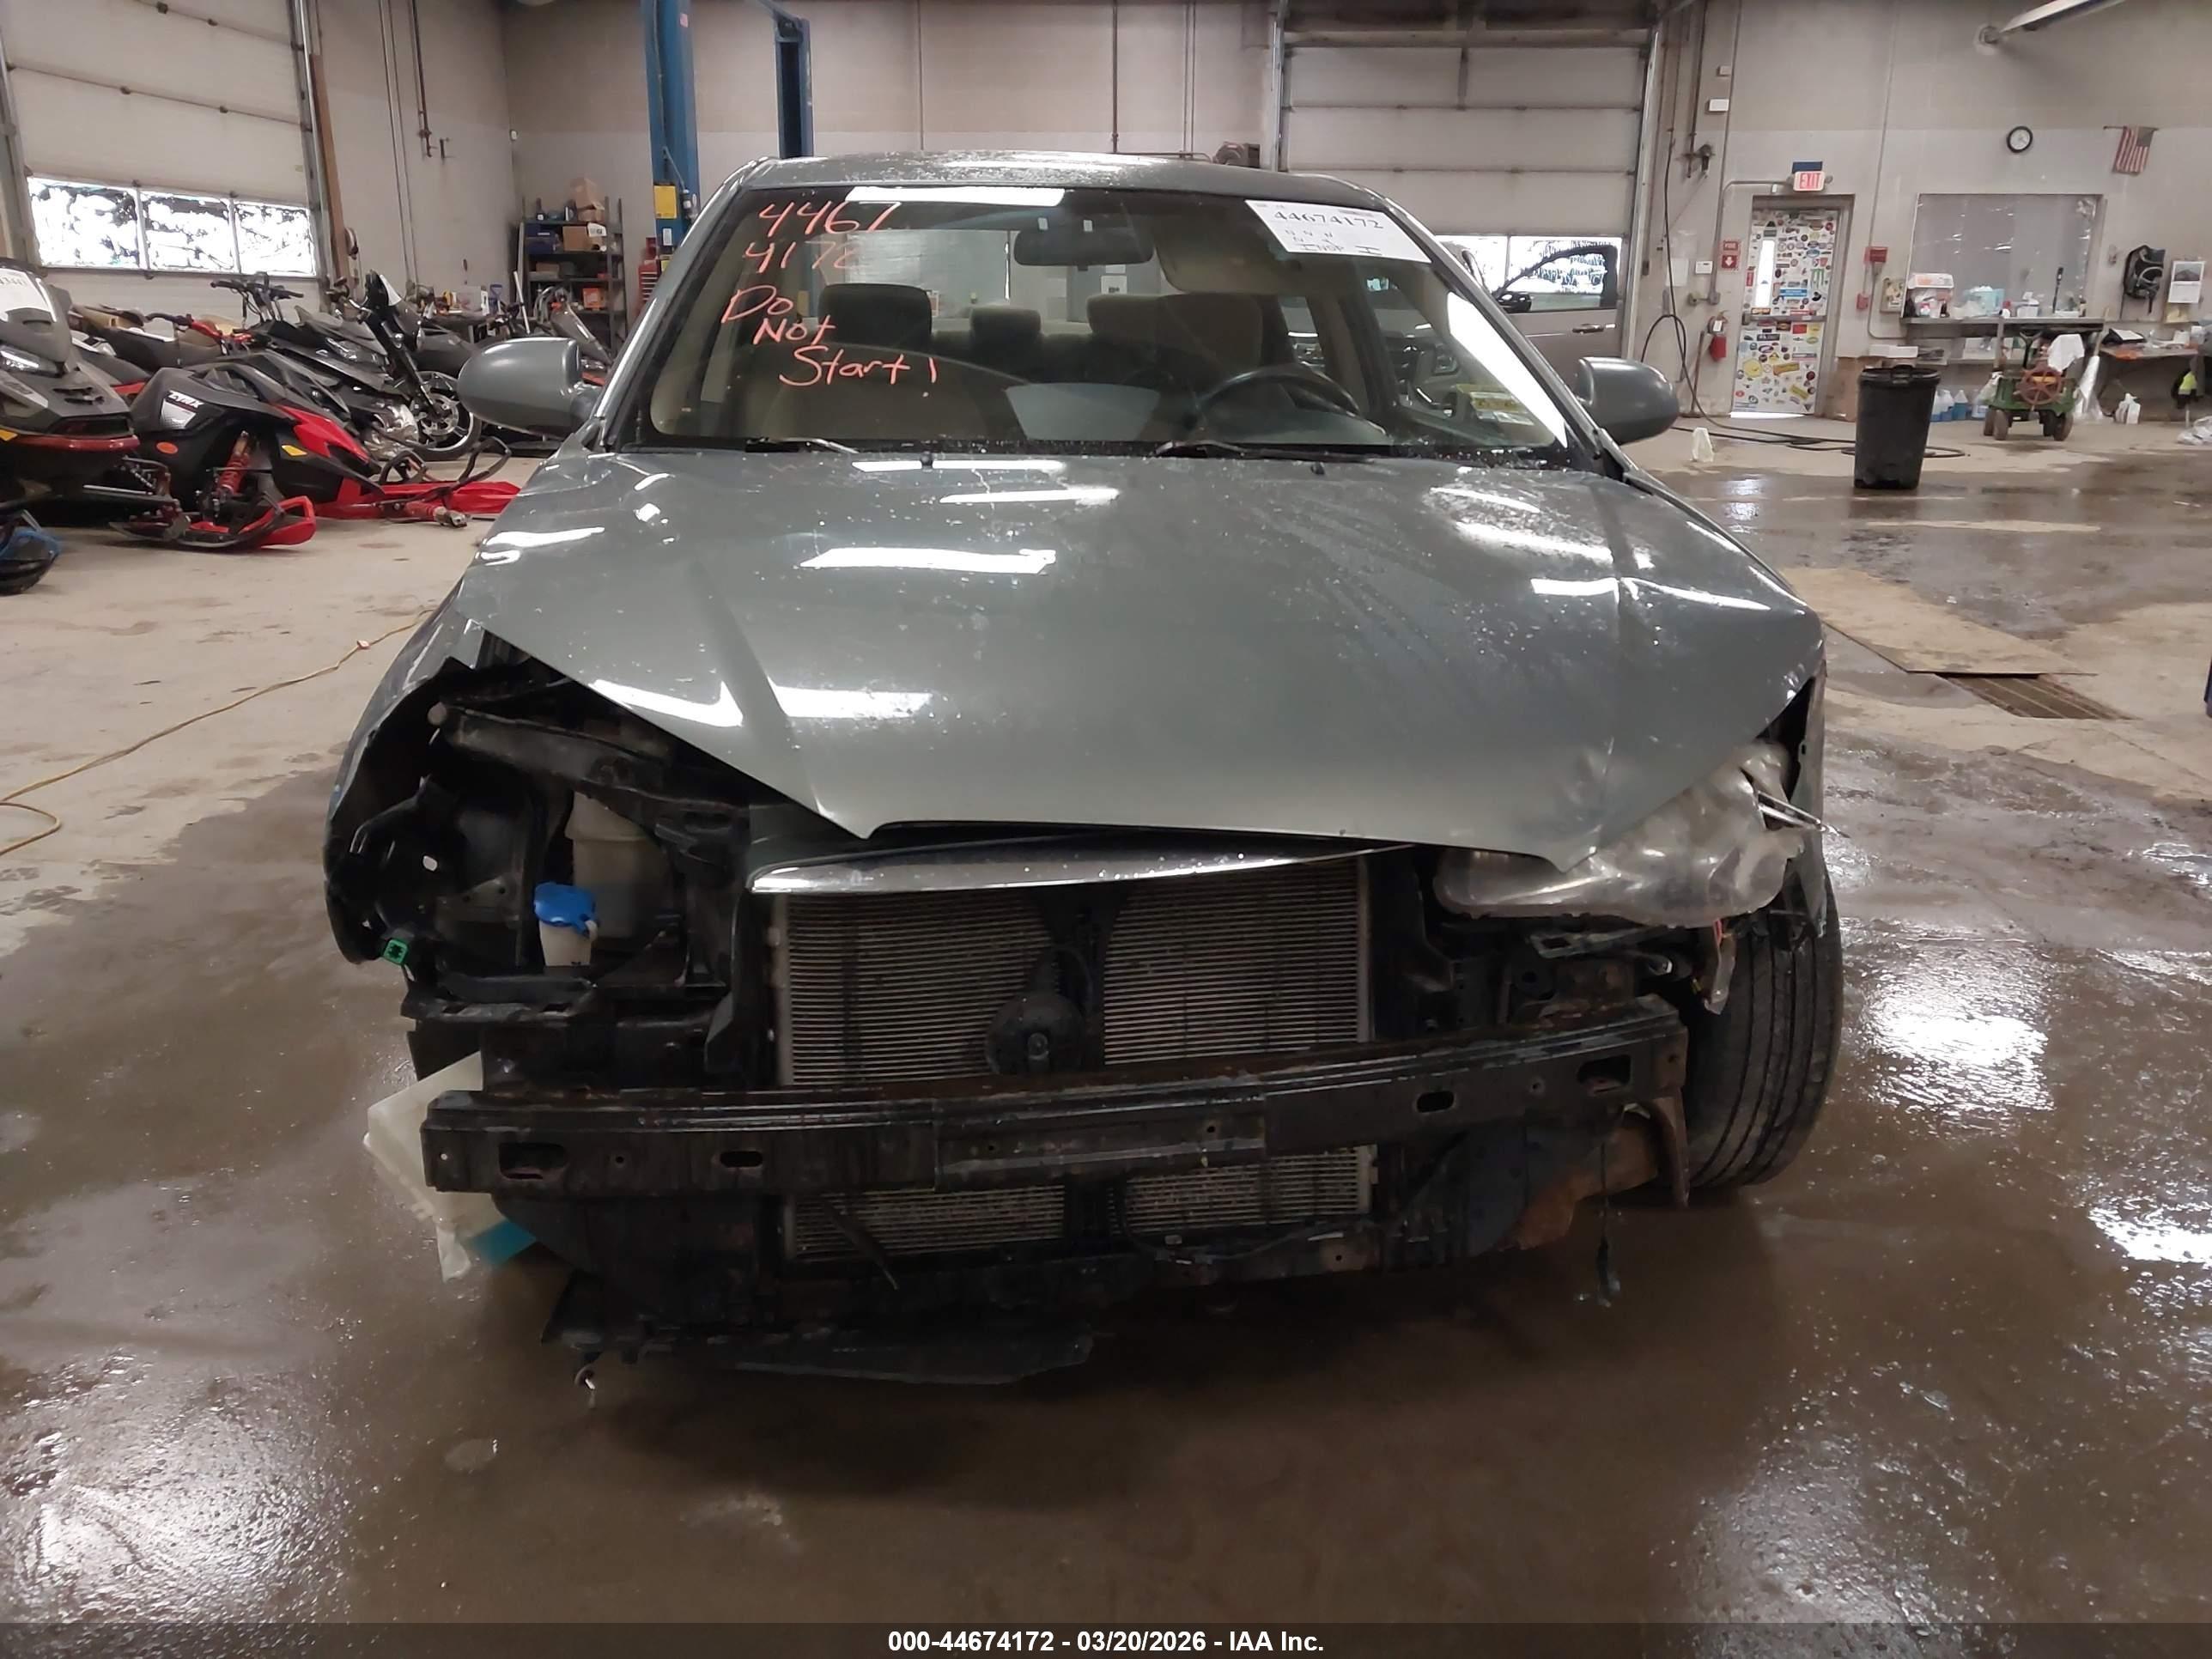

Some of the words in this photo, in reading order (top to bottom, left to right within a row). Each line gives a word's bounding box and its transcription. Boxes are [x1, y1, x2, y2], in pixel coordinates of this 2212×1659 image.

[1799, 173, 1821, 189] EXIT
[758, 200, 902, 238] 4467
[1274, 210, 1384, 229] 44674172
[720, 284, 794, 324] Do
[752, 314, 837, 345] Not
